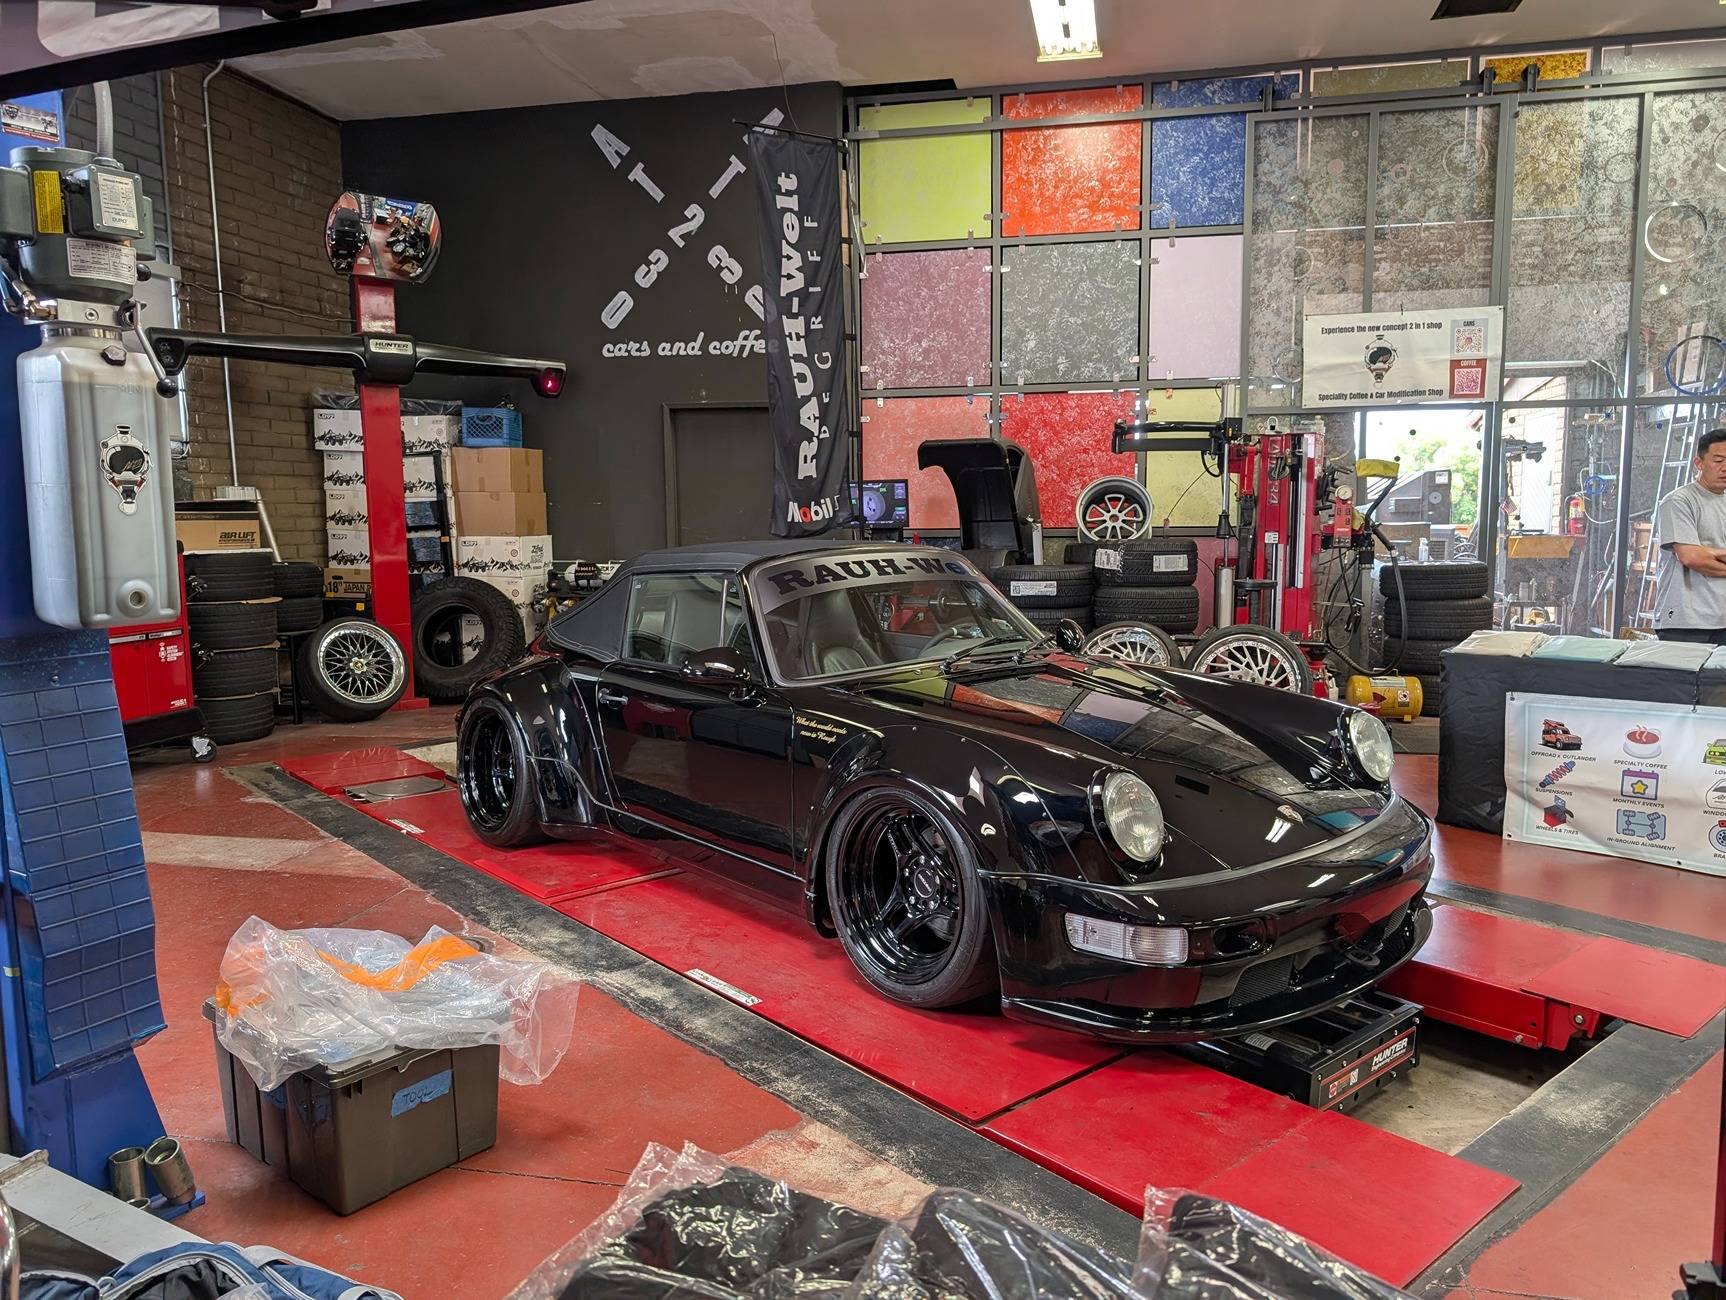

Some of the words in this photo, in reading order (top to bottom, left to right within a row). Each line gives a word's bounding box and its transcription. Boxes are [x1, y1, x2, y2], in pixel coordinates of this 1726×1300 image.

[776, 172, 820, 480] RAUH-Welt
[1321, 326, 1355, 335] Experience
[1356, 325, 1367, 333] the
[1367, 325, 1381, 333] new
[1382, 323, 1408, 331] concept
[1409, 322, 1414, 330] 2
[1415, 322, 1421, 330] in
[1422, 322, 1426, 330] 1
[1426, 321, 1442, 330] shop
[375, 341, 409, 349] HUNTER
[602, 341, 651, 358] cars
[657, 332, 705, 356] and
[1349, 391, 1369, 400] Coffee
[1375, 391, 1386, 399] Car
[1386, 388, 1427, 399] Modification
[1427, 388, 1444, 397] Shop
[787, 497, 833, 523] Mobil
[239, 531, 256, 539] LIFT
[1563, 754, 1596, 762] OUTLANDER
[1535, 787, 1573, 796] SUSPENSIONS
[1606, 837, 1640, 846] IN-GROUND
[1640, 842, 1676, 851] ALIGNMENT
[1372, 1038, 1408, 1066] HUNTER
[402, 1087, 434, 1104] TOOL
